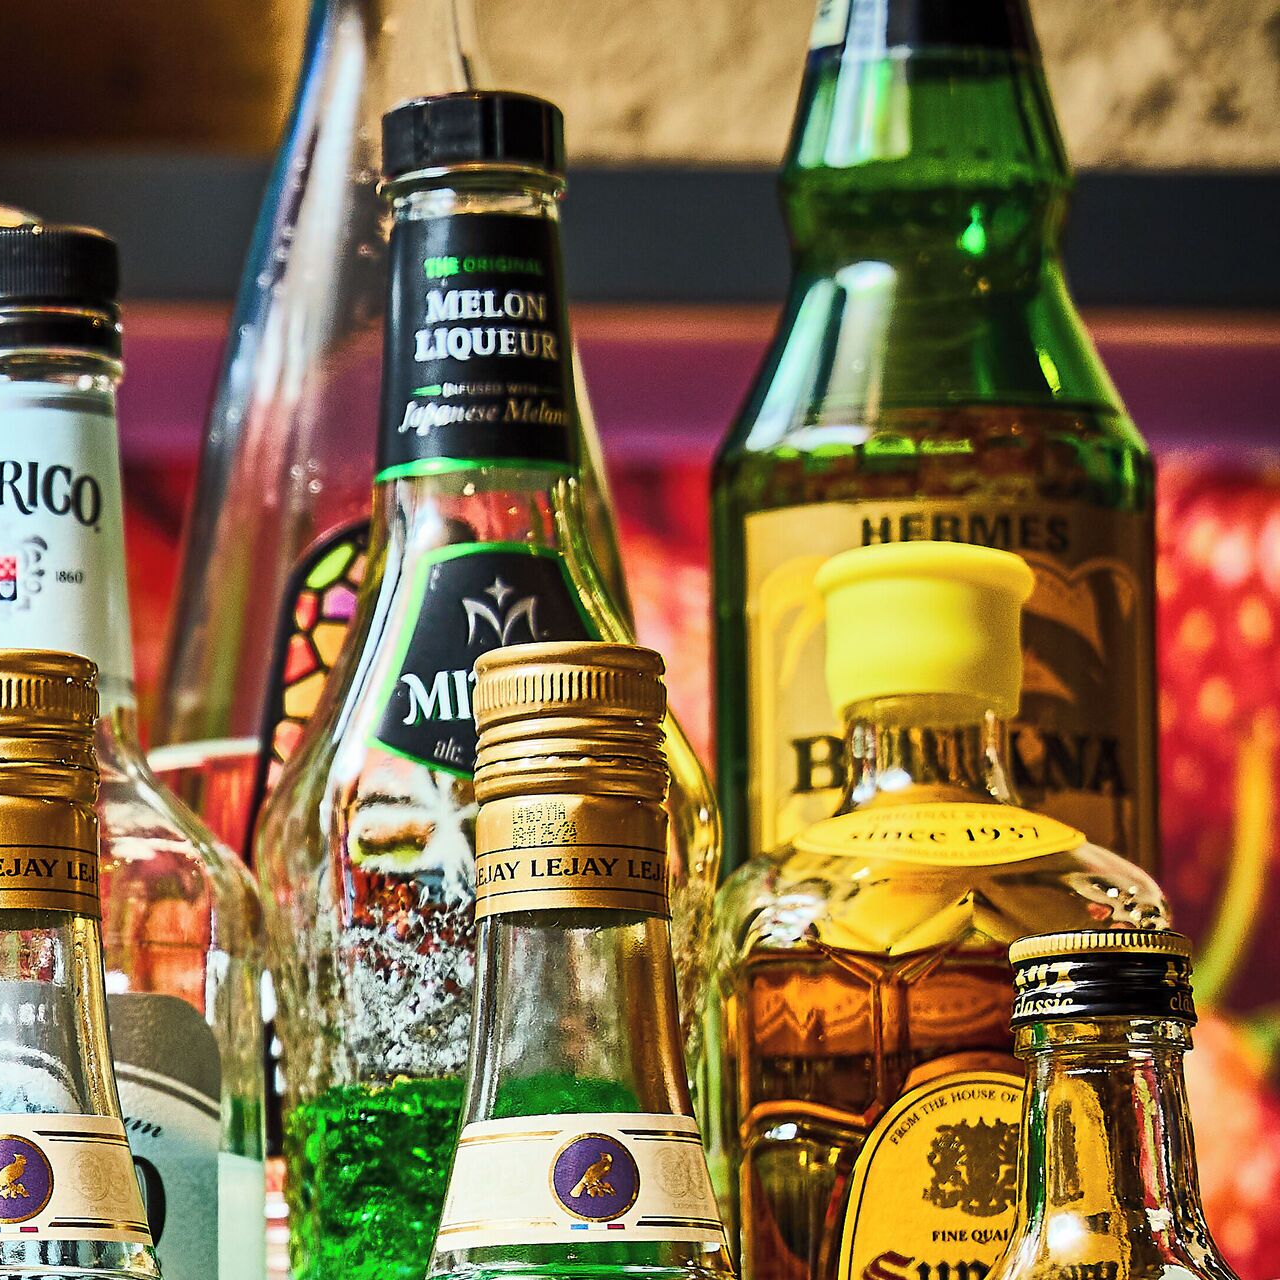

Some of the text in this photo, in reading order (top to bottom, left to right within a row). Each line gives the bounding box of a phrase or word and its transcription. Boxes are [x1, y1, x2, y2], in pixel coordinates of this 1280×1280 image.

[424, 257, 541, 278] THE ORIGINAL
[427, 291, 545, 321] MELON
[415, 326, 558, 361] LIQUEUR
[399, 401, 497, 435] Japanese
[862, 515, 1069, 545] HERMES
[55, 571, 83, 584] 1860
[531, 858, 619, 877] LEJAY
[1014, 992, 1073, 1018] classic
[890, 1090, 1018, 1144] FROM THE HOUSE OF
[932, 1231, 967, 1241] FINE
